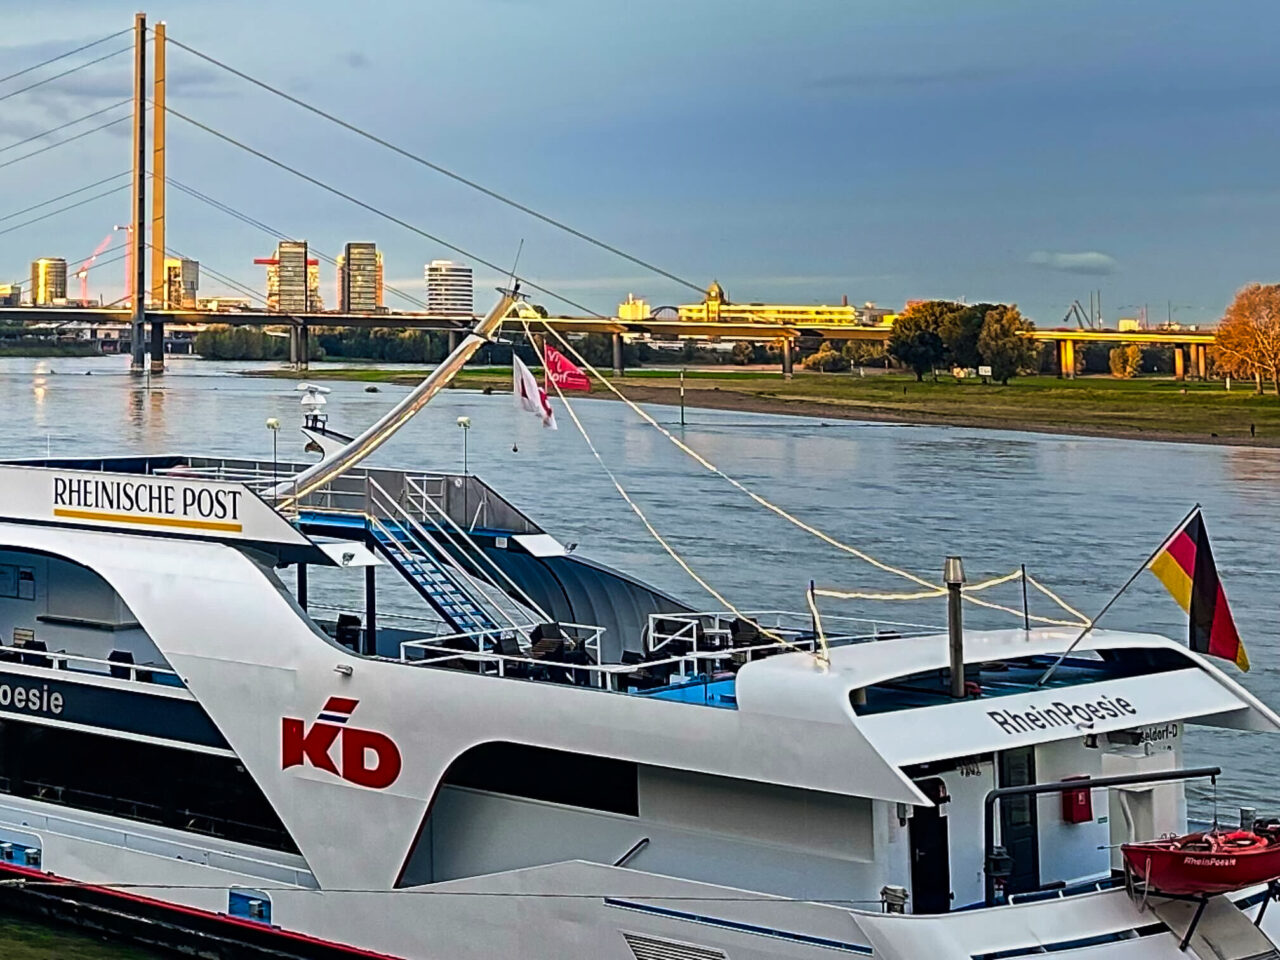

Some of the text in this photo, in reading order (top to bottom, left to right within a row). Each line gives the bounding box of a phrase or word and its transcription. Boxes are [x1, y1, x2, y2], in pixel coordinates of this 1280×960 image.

[53, 477, 242, 520] RHEINISCHE POST
[986, 695, 1137, 735] RheinPoesie
[281, 696, 402, 789] KD
